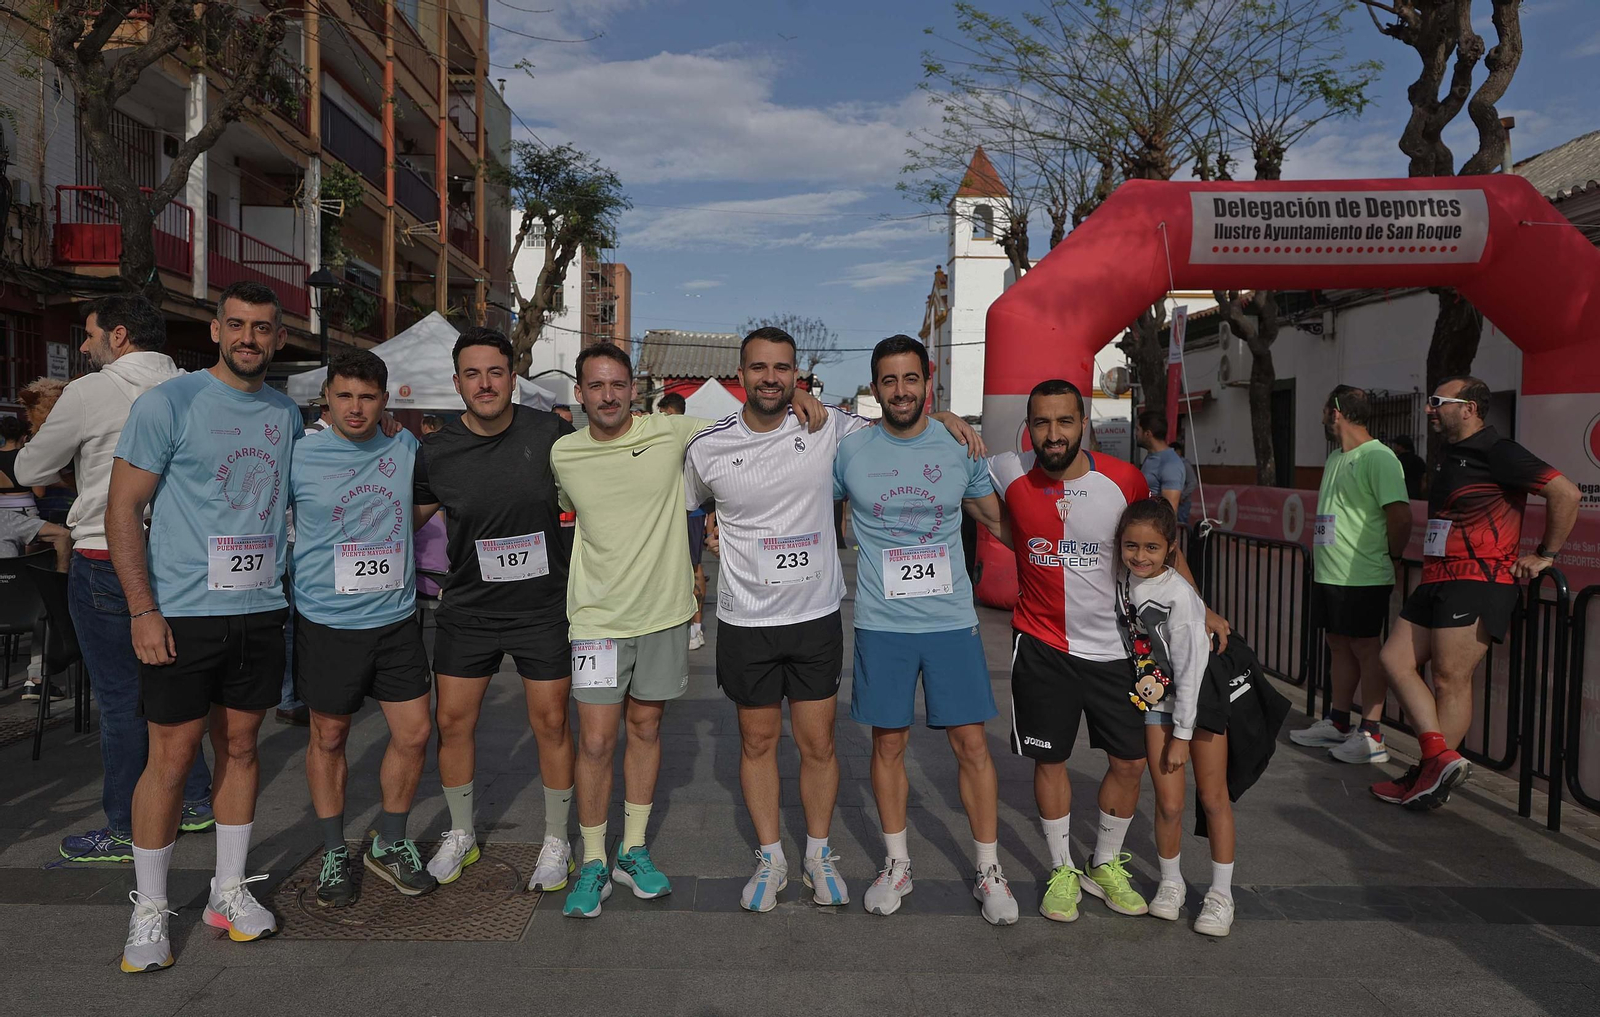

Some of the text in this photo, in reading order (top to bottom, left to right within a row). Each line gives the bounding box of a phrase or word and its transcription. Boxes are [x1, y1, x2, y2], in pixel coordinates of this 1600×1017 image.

[1213, 196, 1462, 220] Delegación de Deportes
[1213, 223, 1462, 242] Ilustre Ayuntamiento de San Roque
[215, 447, 280, 521] VIII CARRERA POPULAR
[332, 505, 344, 522] VIII
[341, 484, 393, 504] CARRERA
[872, 486, 943, 544] VIII CARRERA POPUAR
[506, 542, 532, 550] MAYORGA
[787, 541, 811, 549] MAYORGA
[889, 549, 902, 557] VIII
[1058, 540, 1099, 555] 威视
[1582, 542, 1596, 552] San
[230, 554, 264, 572] 237
[354, 558, 390, 577] 236
[496, 551, 529, 568] 187
[775, 551, 809, 569] 233
[1029, 553, 1099, 567] NUCTECH
[1563, 554, 1600, 568] DEPORTES
[900, 562, 936, 581] 234
